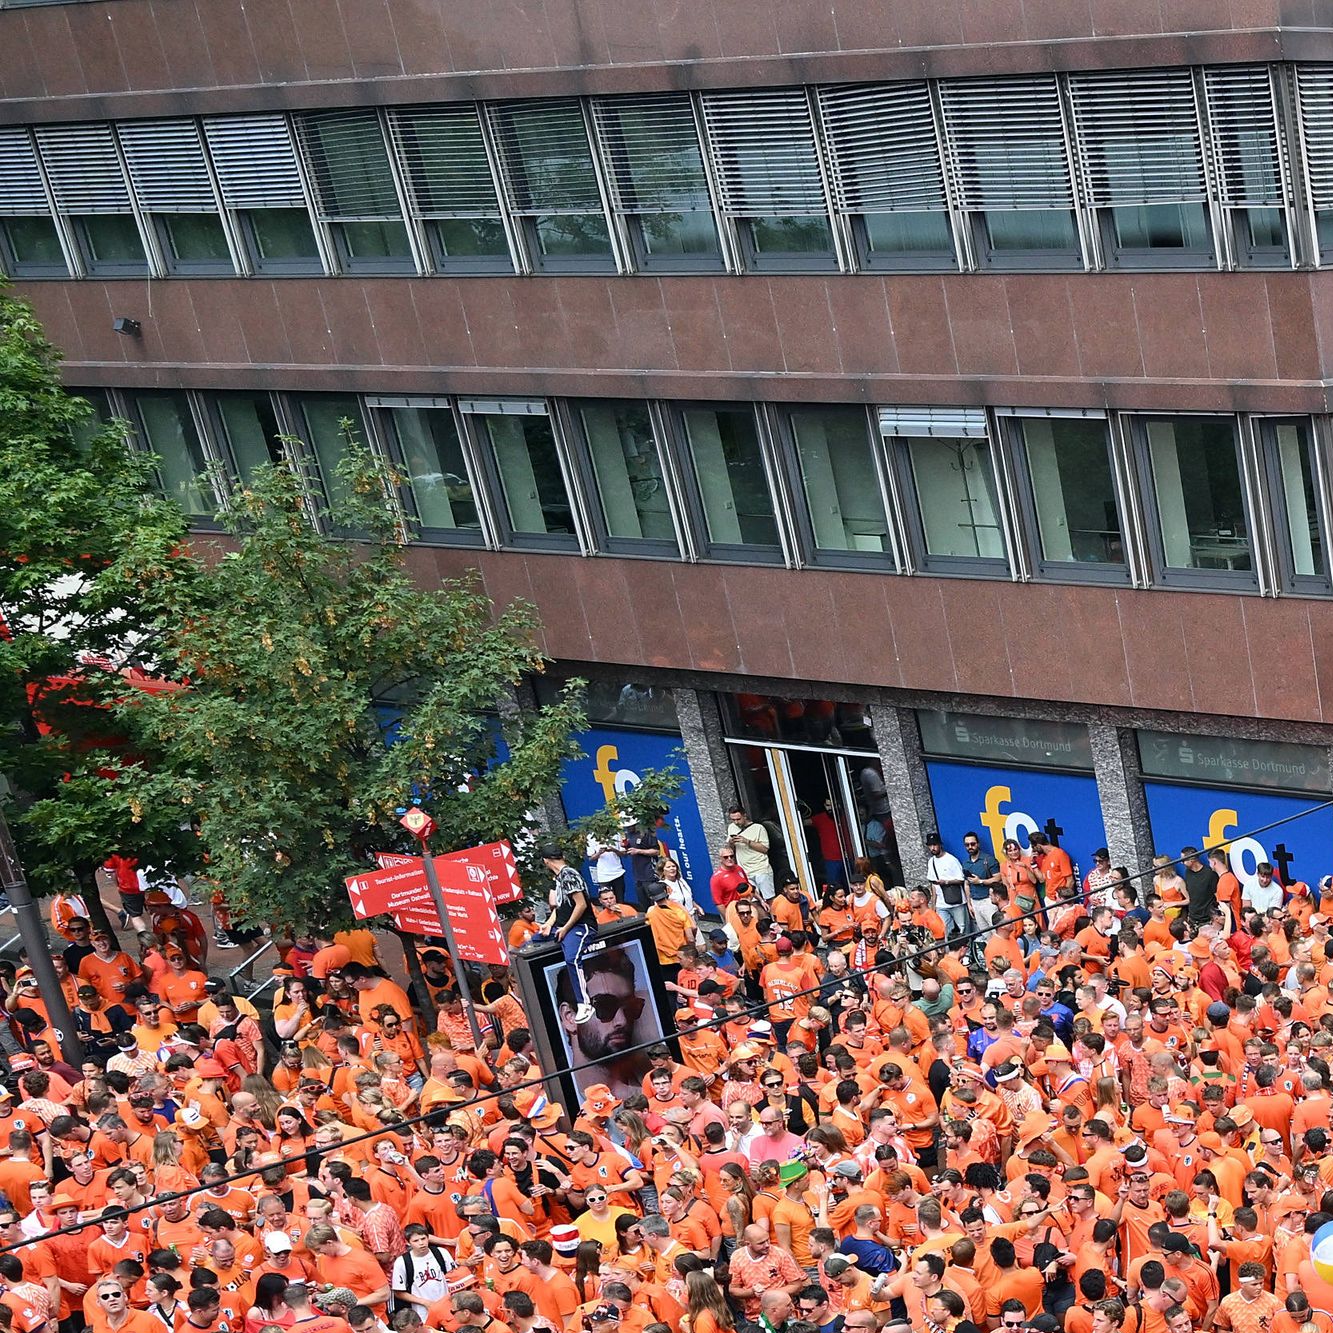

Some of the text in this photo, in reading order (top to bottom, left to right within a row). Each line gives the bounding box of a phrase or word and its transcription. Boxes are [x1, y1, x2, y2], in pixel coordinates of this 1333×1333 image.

[971, 731, 1071, 753] Sparkasse Dortmund
[1196, 754, 1307, 775] Sparkasse Dortmund
[674, 816, 688, 850] hearts.
[681, 852, 691, 869] our
[375, 869, 424, 885] Tourist-Information
[391, 886, 422, 899] Dortmunder
[387, 898, 409, 908] Museum
[687, 980, 696, 989] 10
